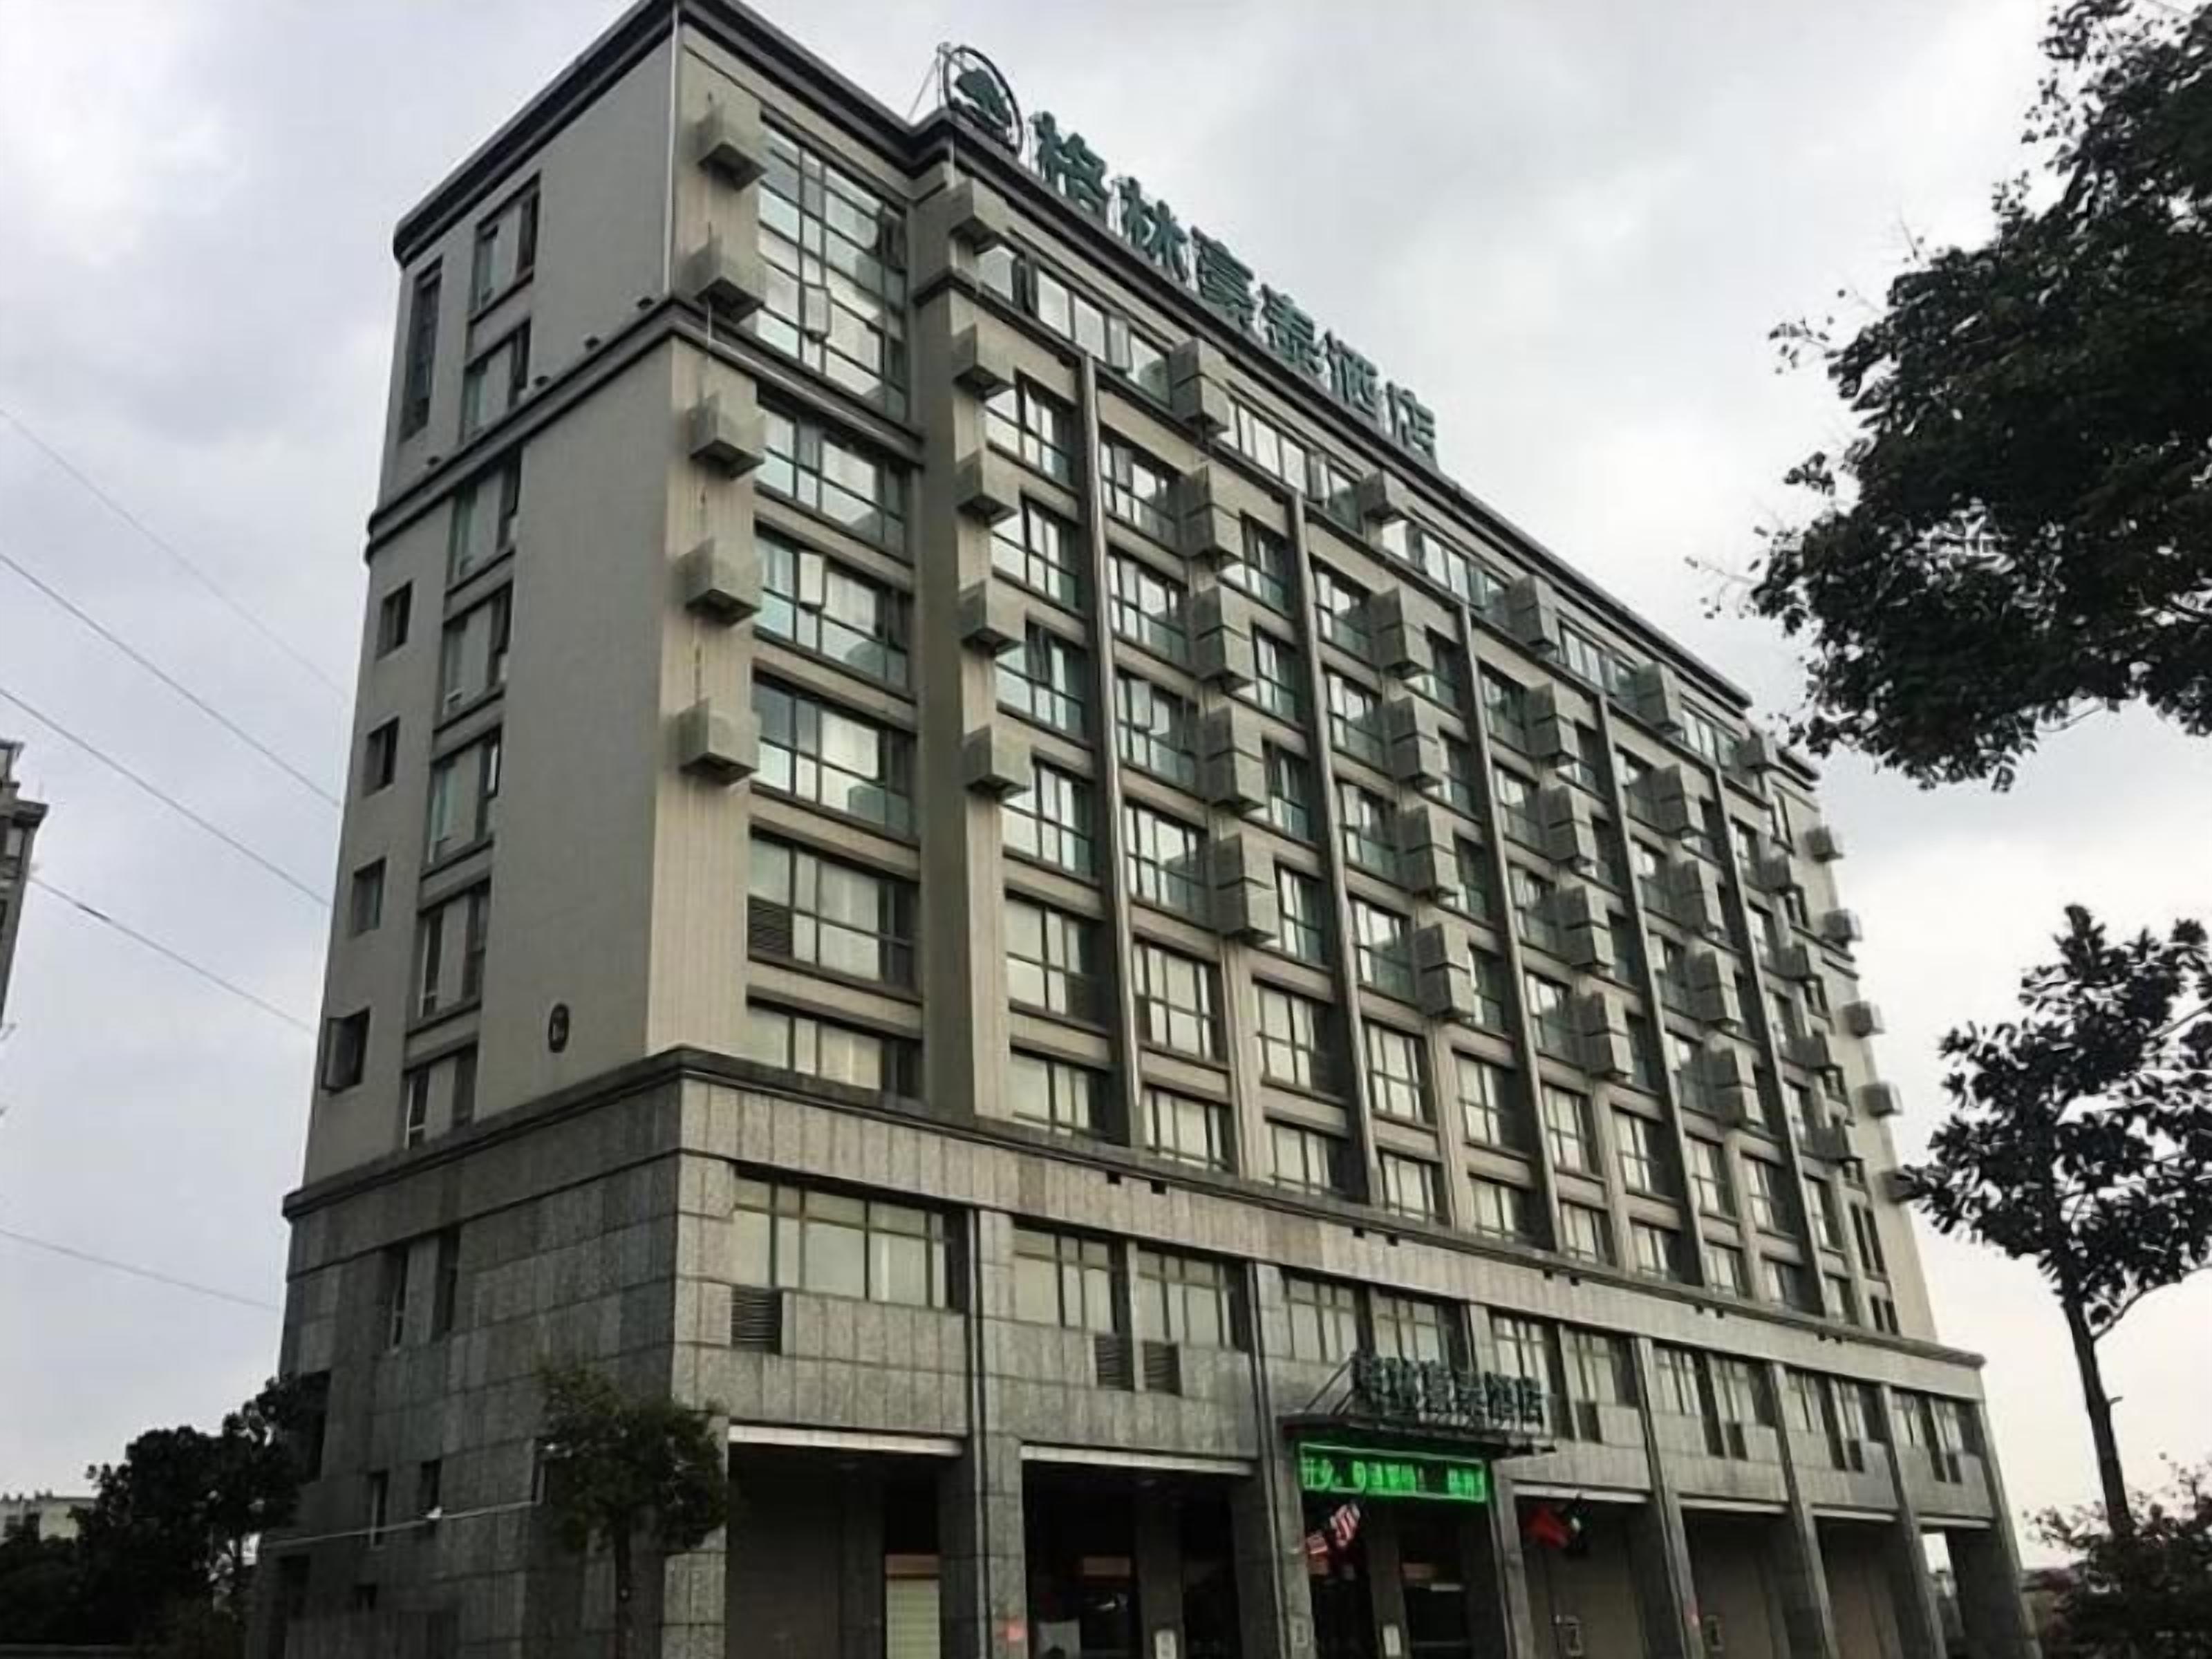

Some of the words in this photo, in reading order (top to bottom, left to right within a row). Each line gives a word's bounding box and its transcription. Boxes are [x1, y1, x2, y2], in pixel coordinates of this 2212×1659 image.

[1034, 111, 1437, 459] 格林豪泰酒店
